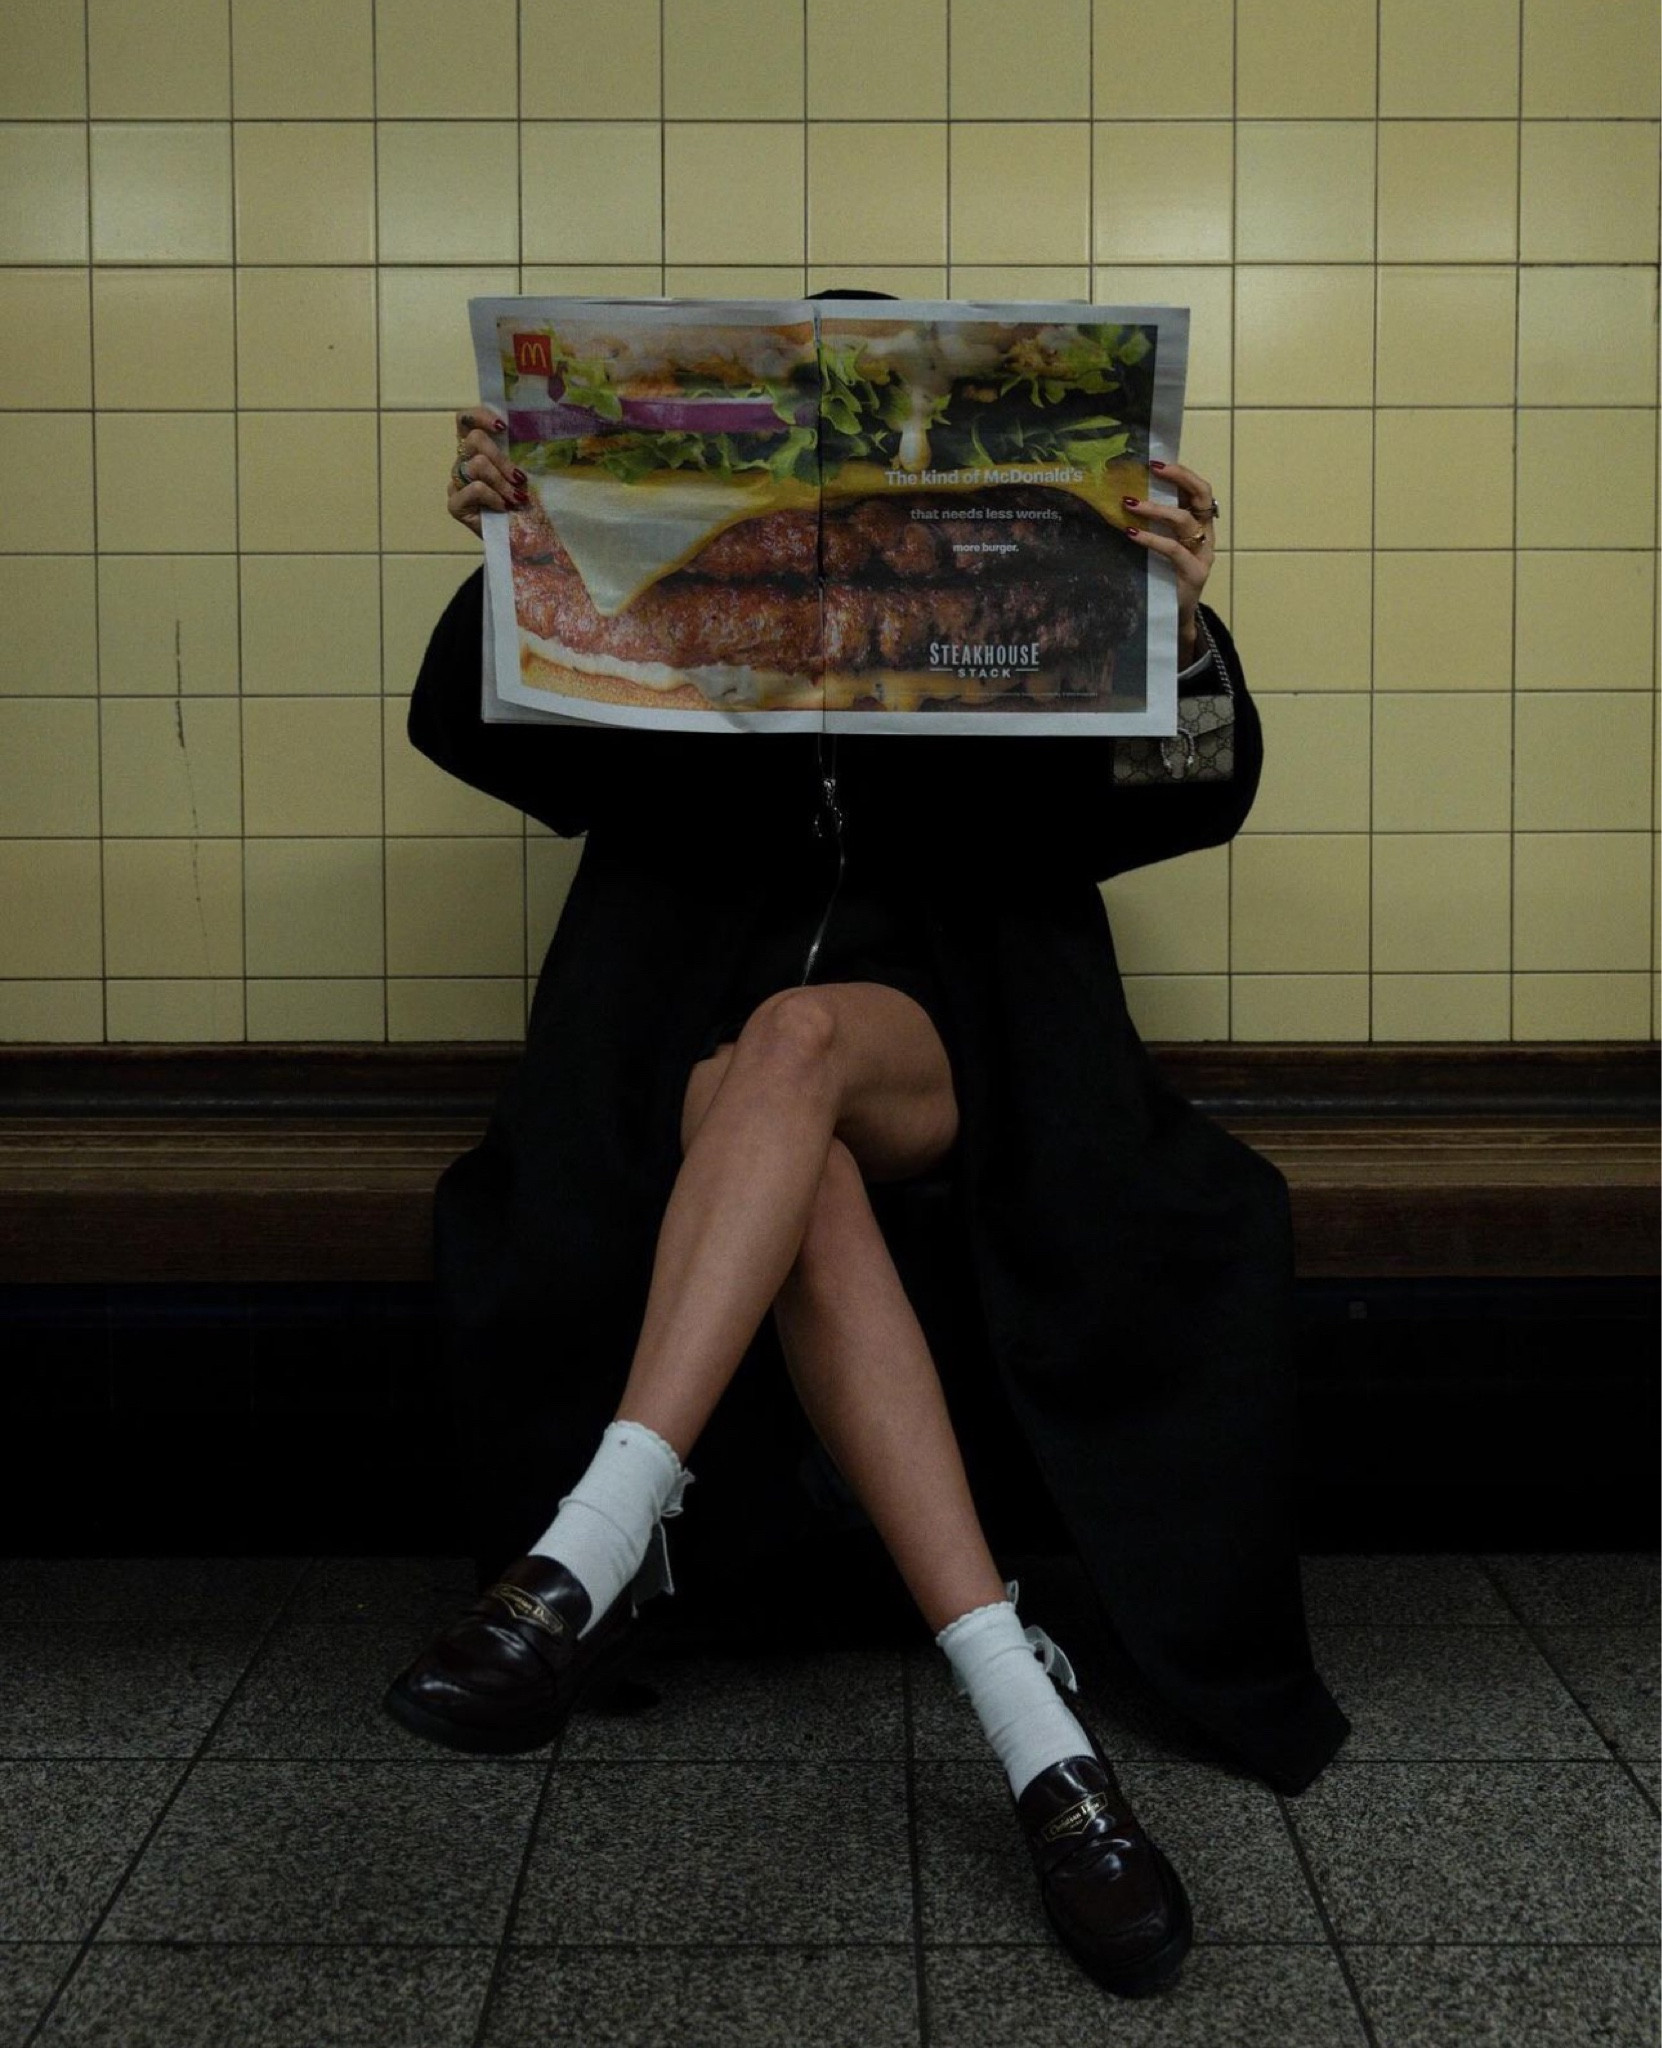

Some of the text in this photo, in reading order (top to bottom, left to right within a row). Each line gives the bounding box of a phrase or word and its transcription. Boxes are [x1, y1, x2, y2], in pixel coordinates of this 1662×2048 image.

[885, 467, 1083, 486] The kind of McDonald’s
[911, 508, 1062, 522] that needs less words,
[952, 543, 1019, 555] more burger.
[929, 642, 1040, 666] STEAKHOUSE
[957, 668, 1011, 678] STACK
